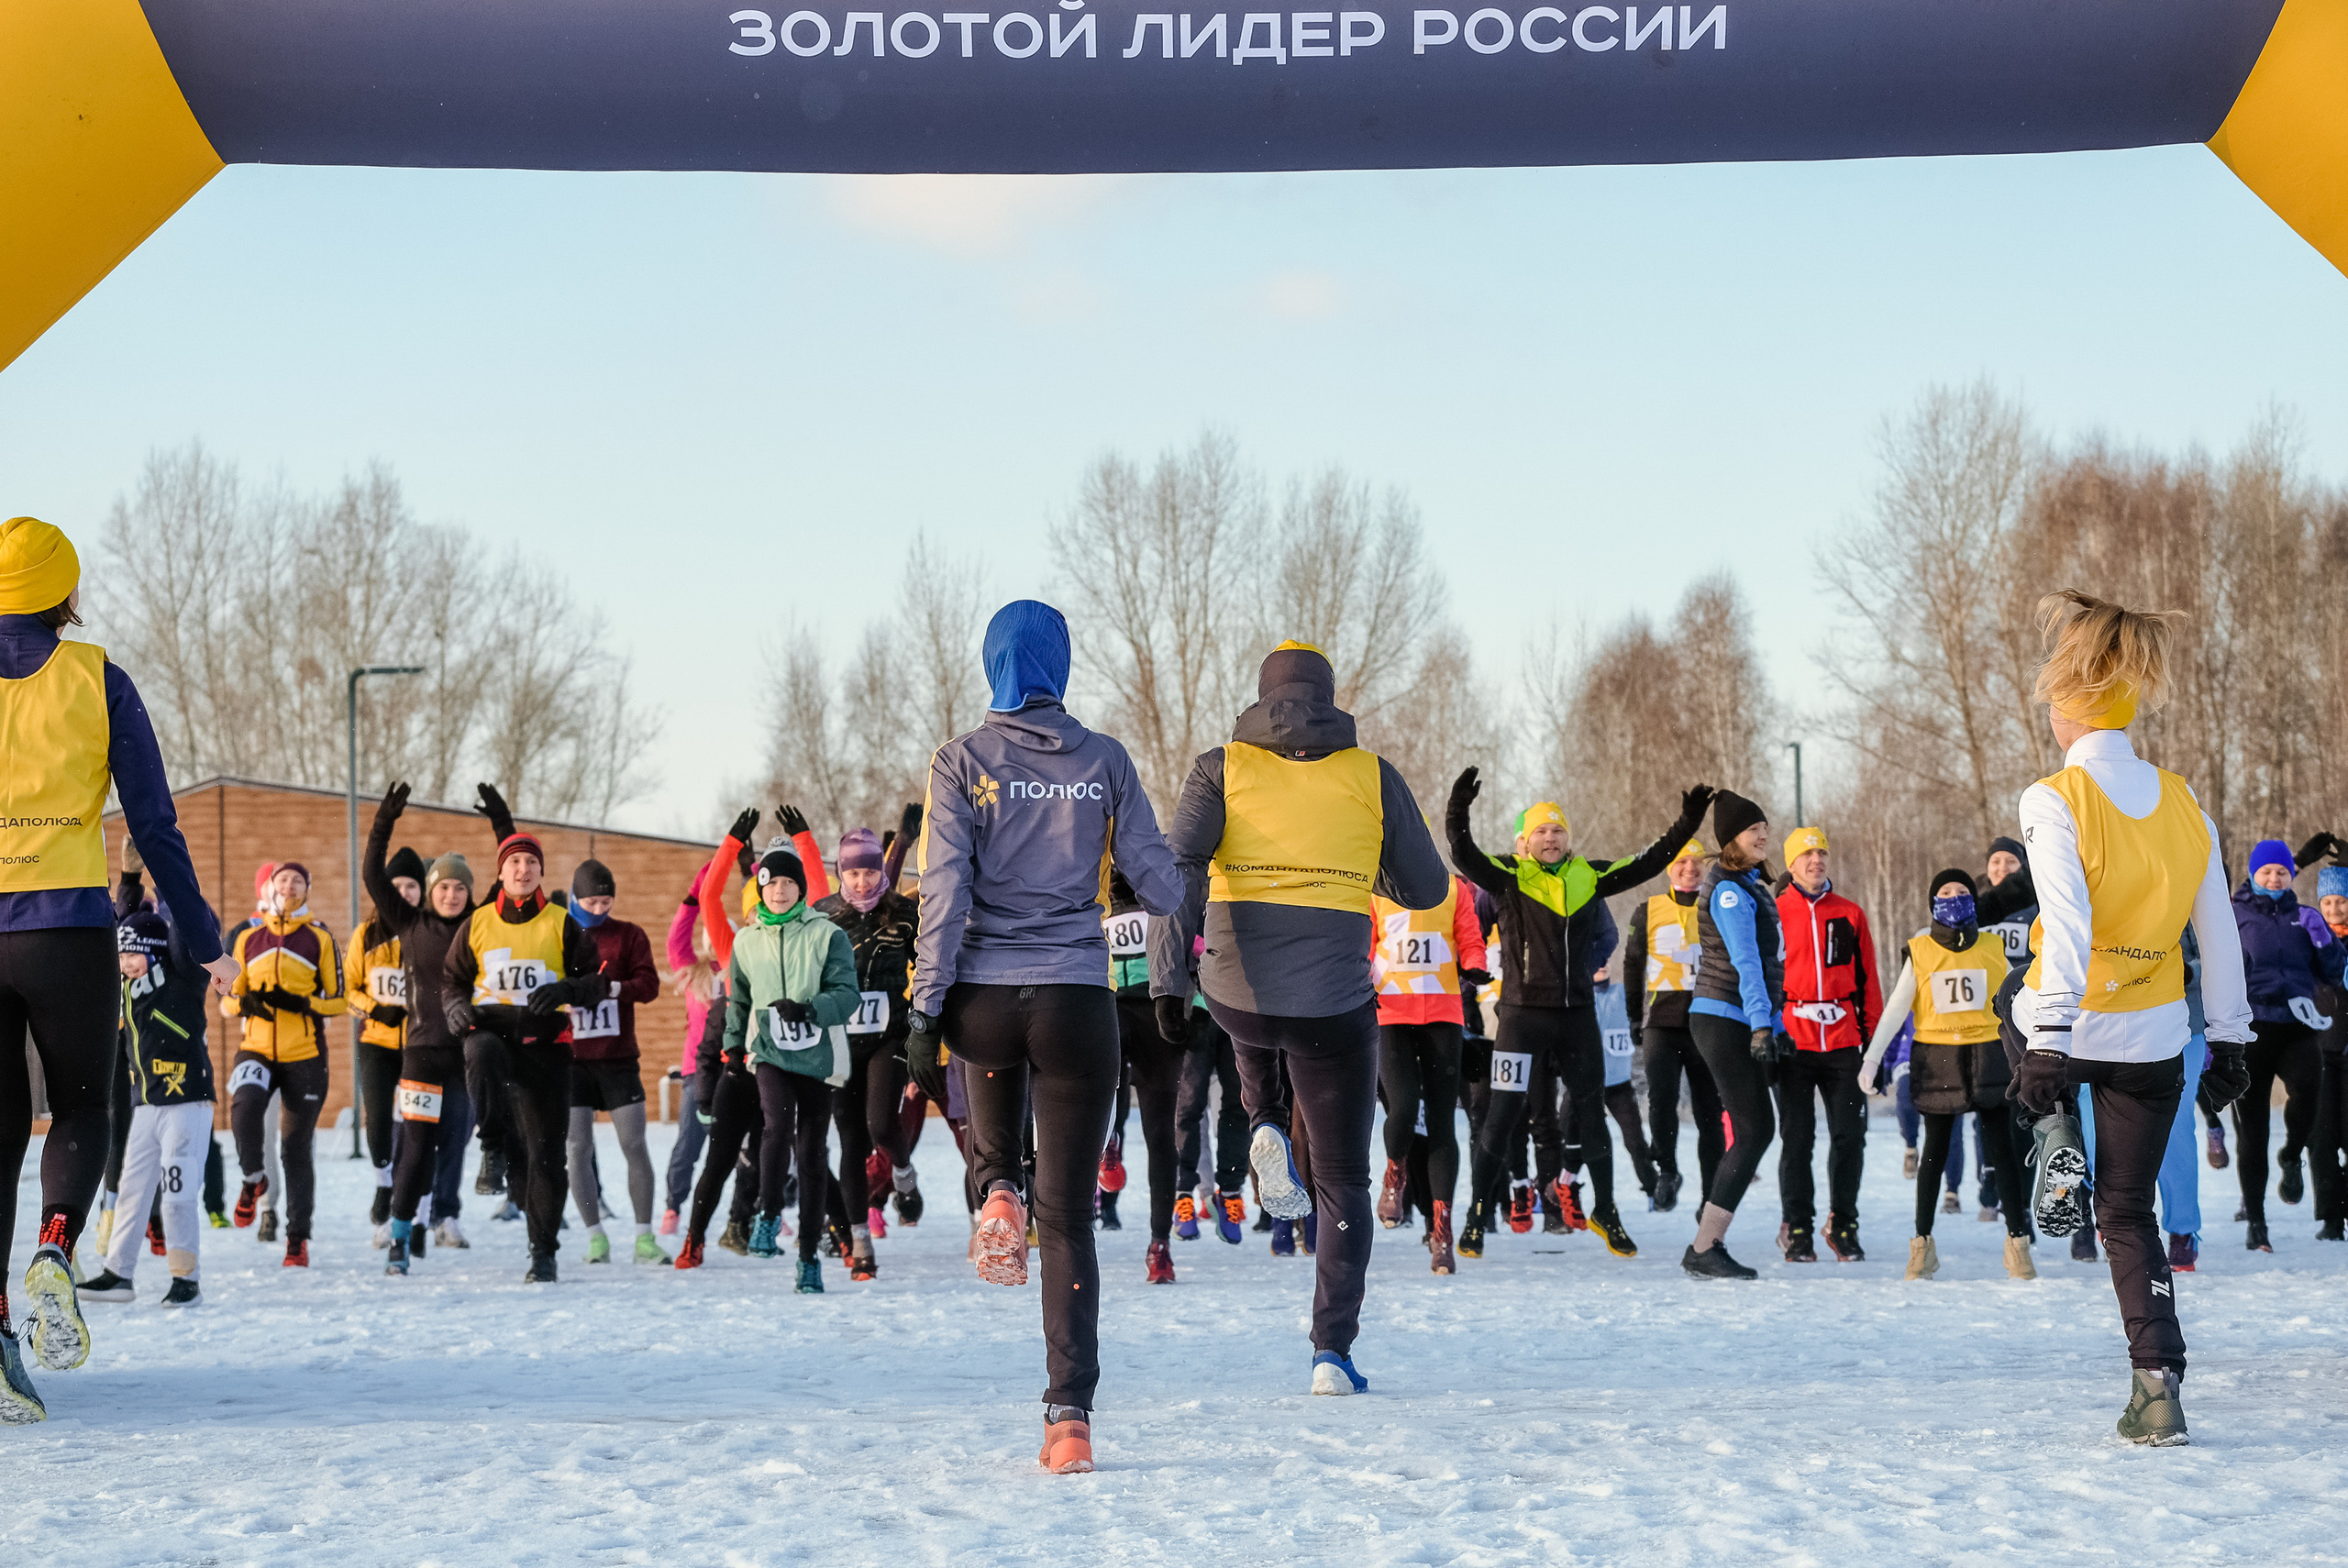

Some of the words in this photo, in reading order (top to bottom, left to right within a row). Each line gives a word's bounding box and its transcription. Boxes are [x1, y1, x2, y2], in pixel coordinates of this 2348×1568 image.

[728, 0, 1098, 58] ЗОЛОТОЙ
[1123, 12, 1386, 66] ЛИДЕР
[1413, 6, 1727, 56] РОССИИ
[1010, 780, 1103, 801] ПОЛЮС
[1396, 938, 1432, 964] 121
[378, 975, 406, 998] 162
[498, 966, 537, 990] 176
[1944, 977, 1974, 1004] 76
[847, 999, 880, 1025] 77
[1610, 1033, 1629, 1051] 175
[1493, 1058, 1523, 1084] 181
[404, 1092, 432, 1109] 542
